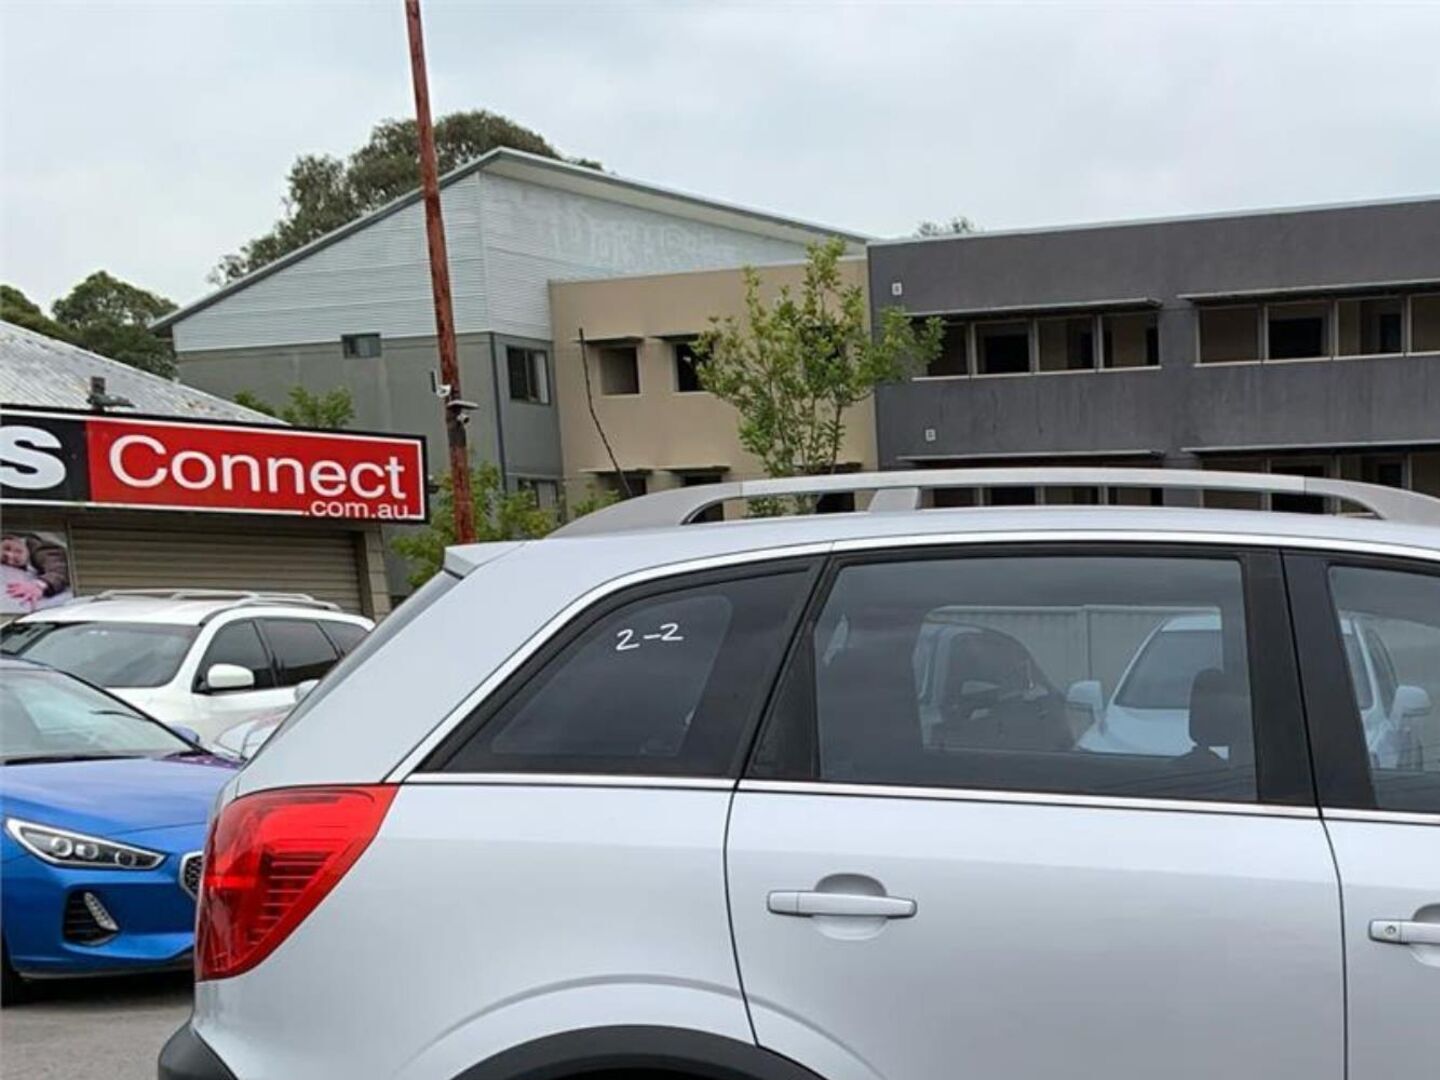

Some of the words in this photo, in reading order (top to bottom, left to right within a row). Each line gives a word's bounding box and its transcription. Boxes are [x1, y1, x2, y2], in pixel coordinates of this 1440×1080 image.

[109, 435, 407, 499] Connect
[303, 500, 409, 520] .com.au
[615, 622, 684, 651] 2-2
